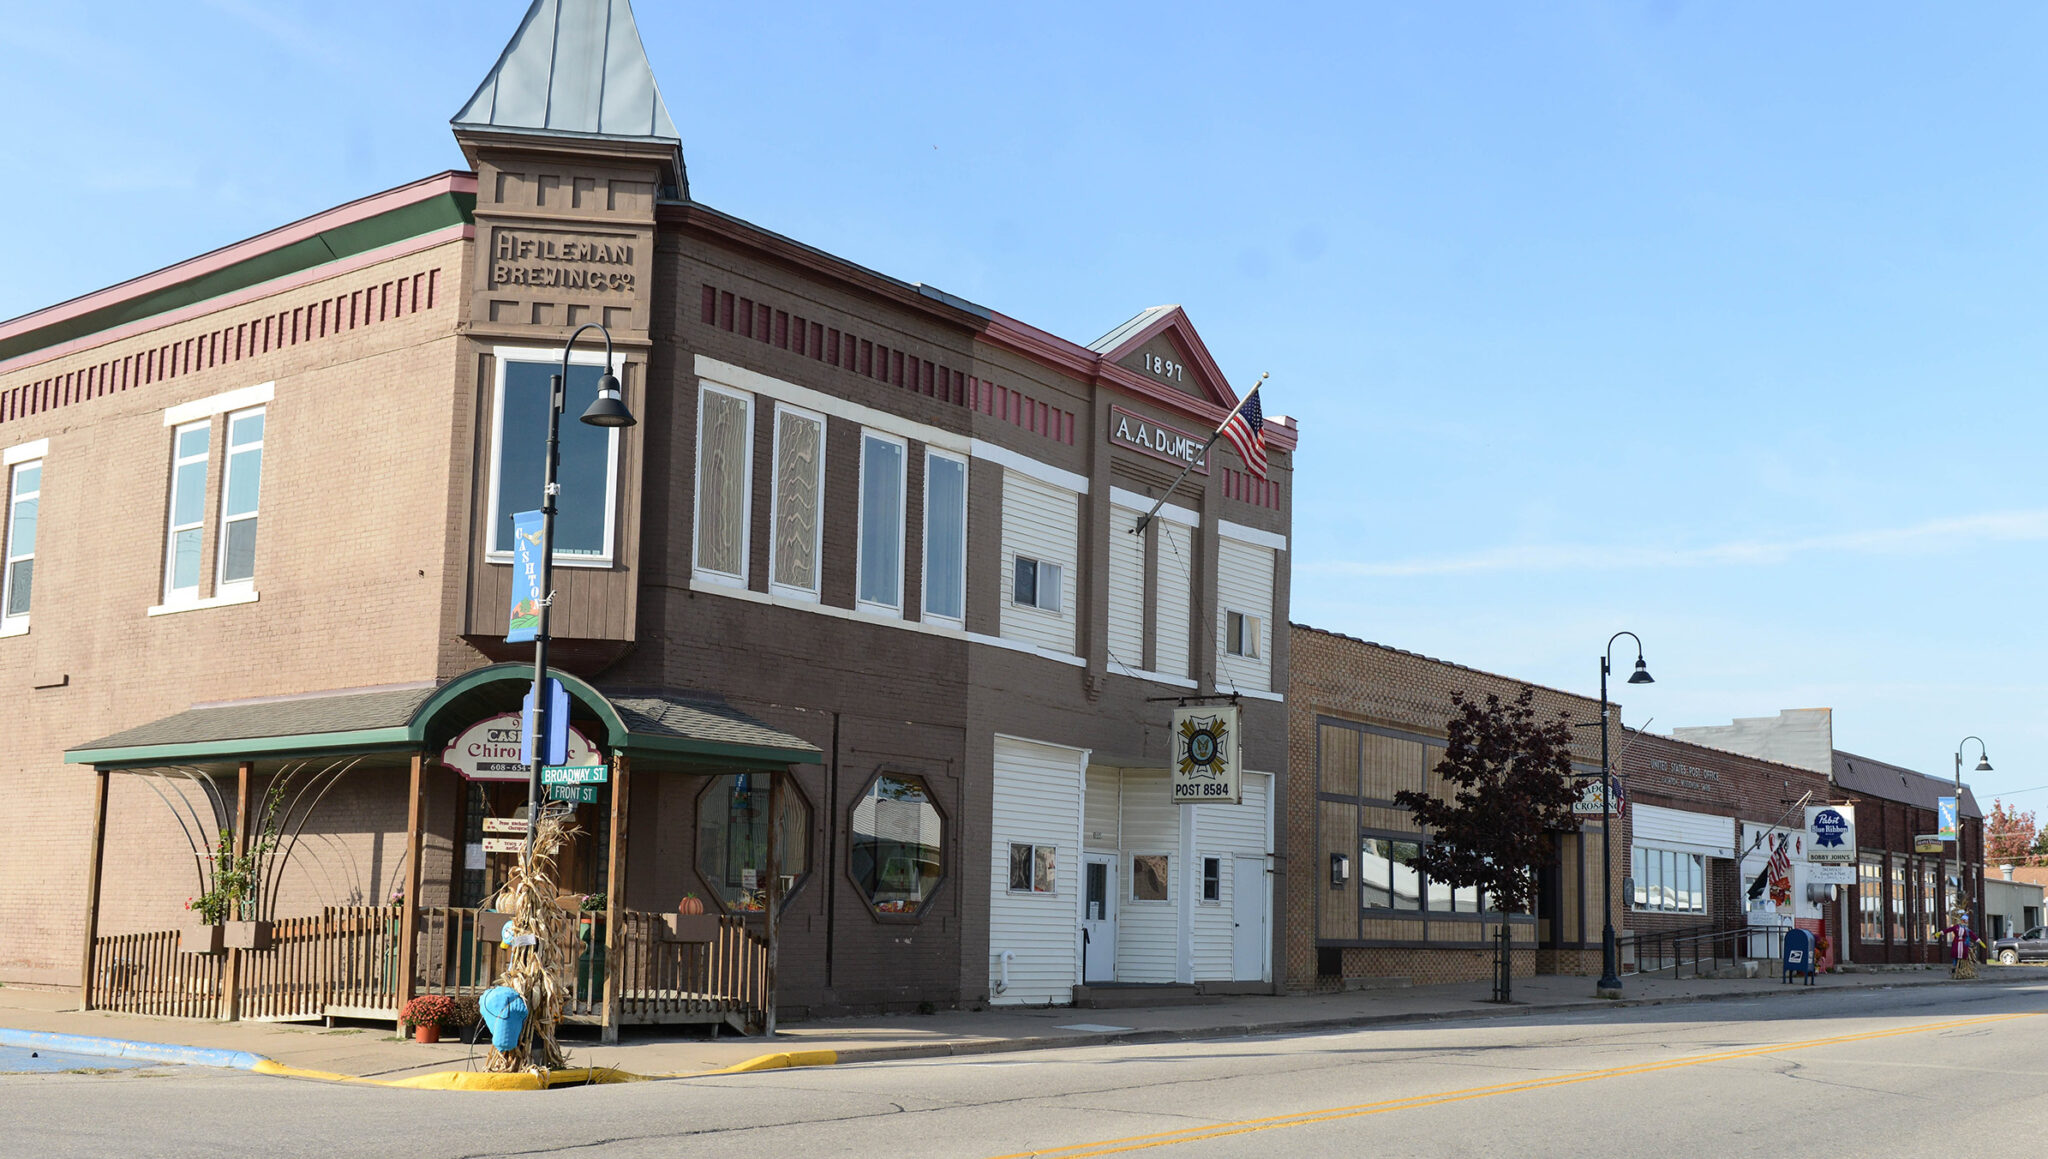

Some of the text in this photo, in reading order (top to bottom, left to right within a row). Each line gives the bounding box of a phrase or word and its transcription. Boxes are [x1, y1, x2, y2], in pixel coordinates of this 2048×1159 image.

[1144, 353, 1182, 382] 1897
[515, 528, 540, 610] CASHTON
[544, 768, 605, 783] BROADWAY ST
[555, 785, 592, 801] FRONT ST
[1176, 783, 1229, 796] POST 8584
[1818, 813, 1840, 824] Pabst
[1826, 824, 1848, 832] Ribbon
